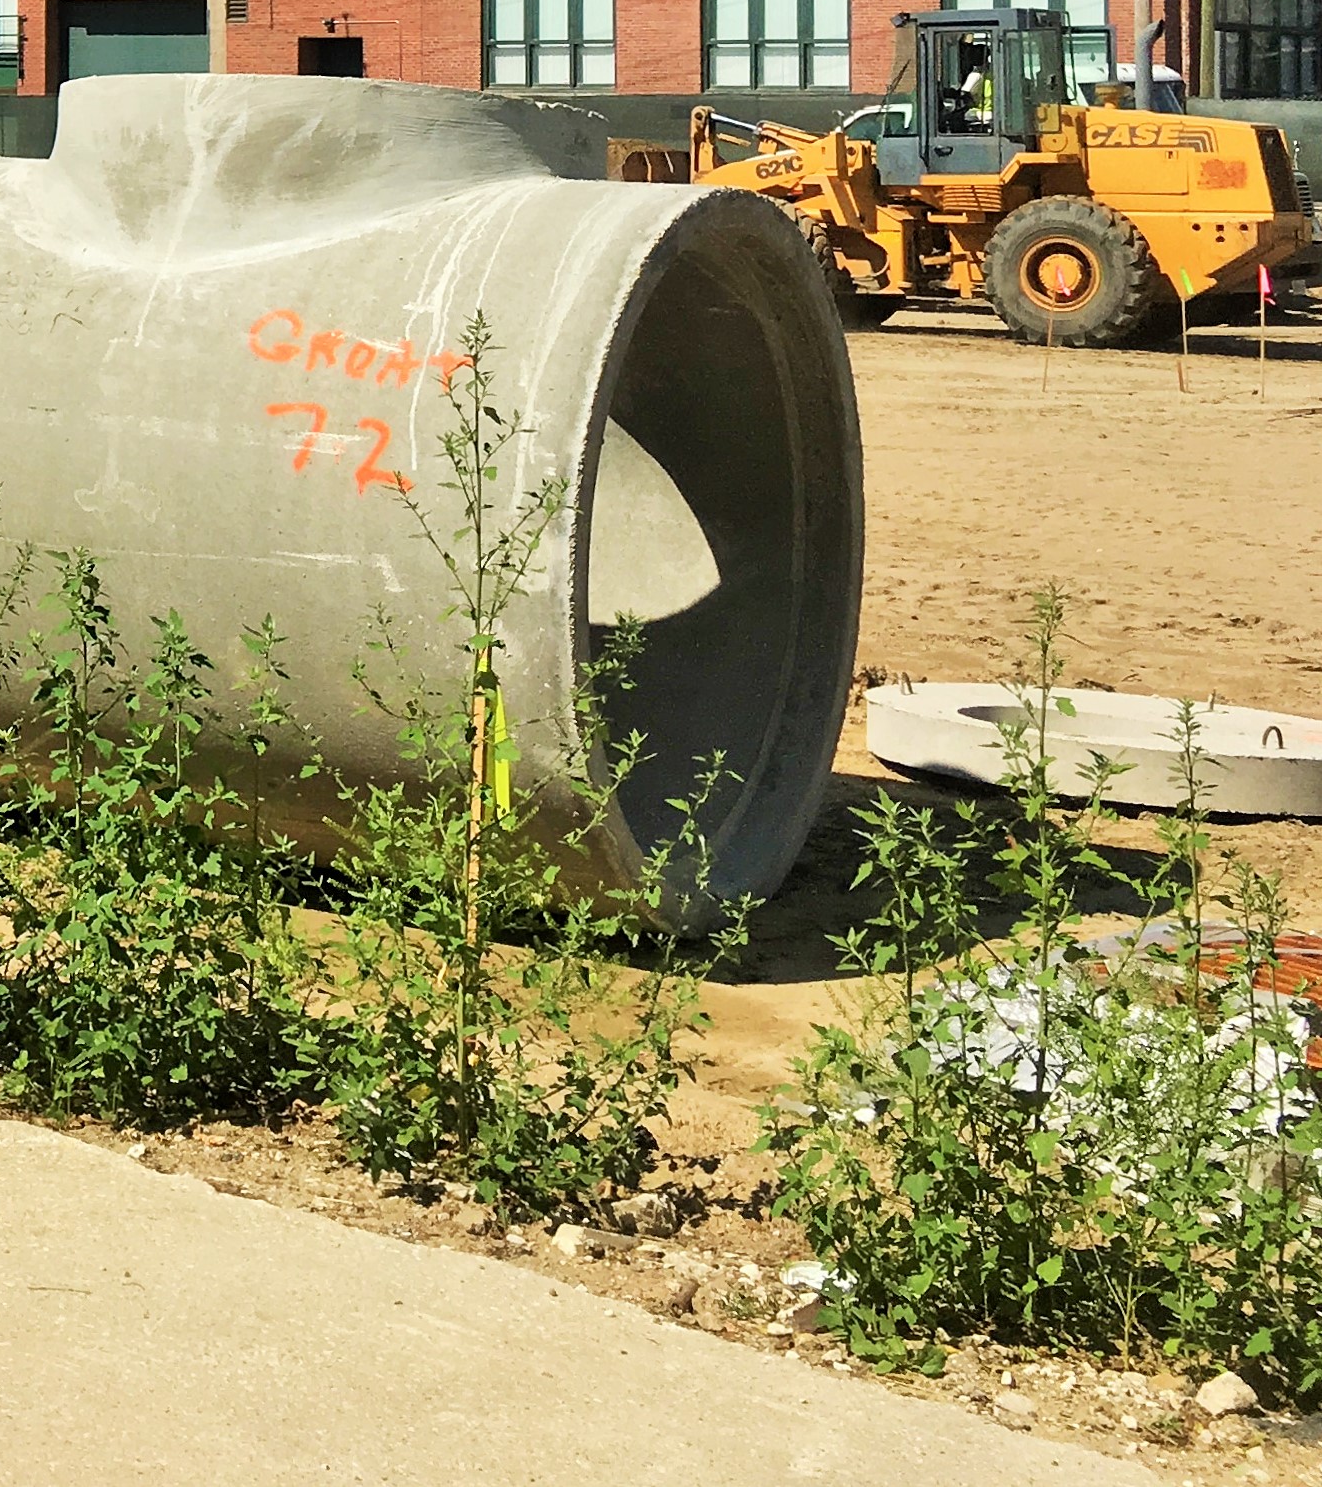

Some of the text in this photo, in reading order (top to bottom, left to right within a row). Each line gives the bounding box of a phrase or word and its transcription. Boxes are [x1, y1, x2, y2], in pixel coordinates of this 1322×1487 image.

[1086, 122, 1186, 147] CASE
[756, 155, 804, 179] 621C
[265, 401, 415, 497] 72
